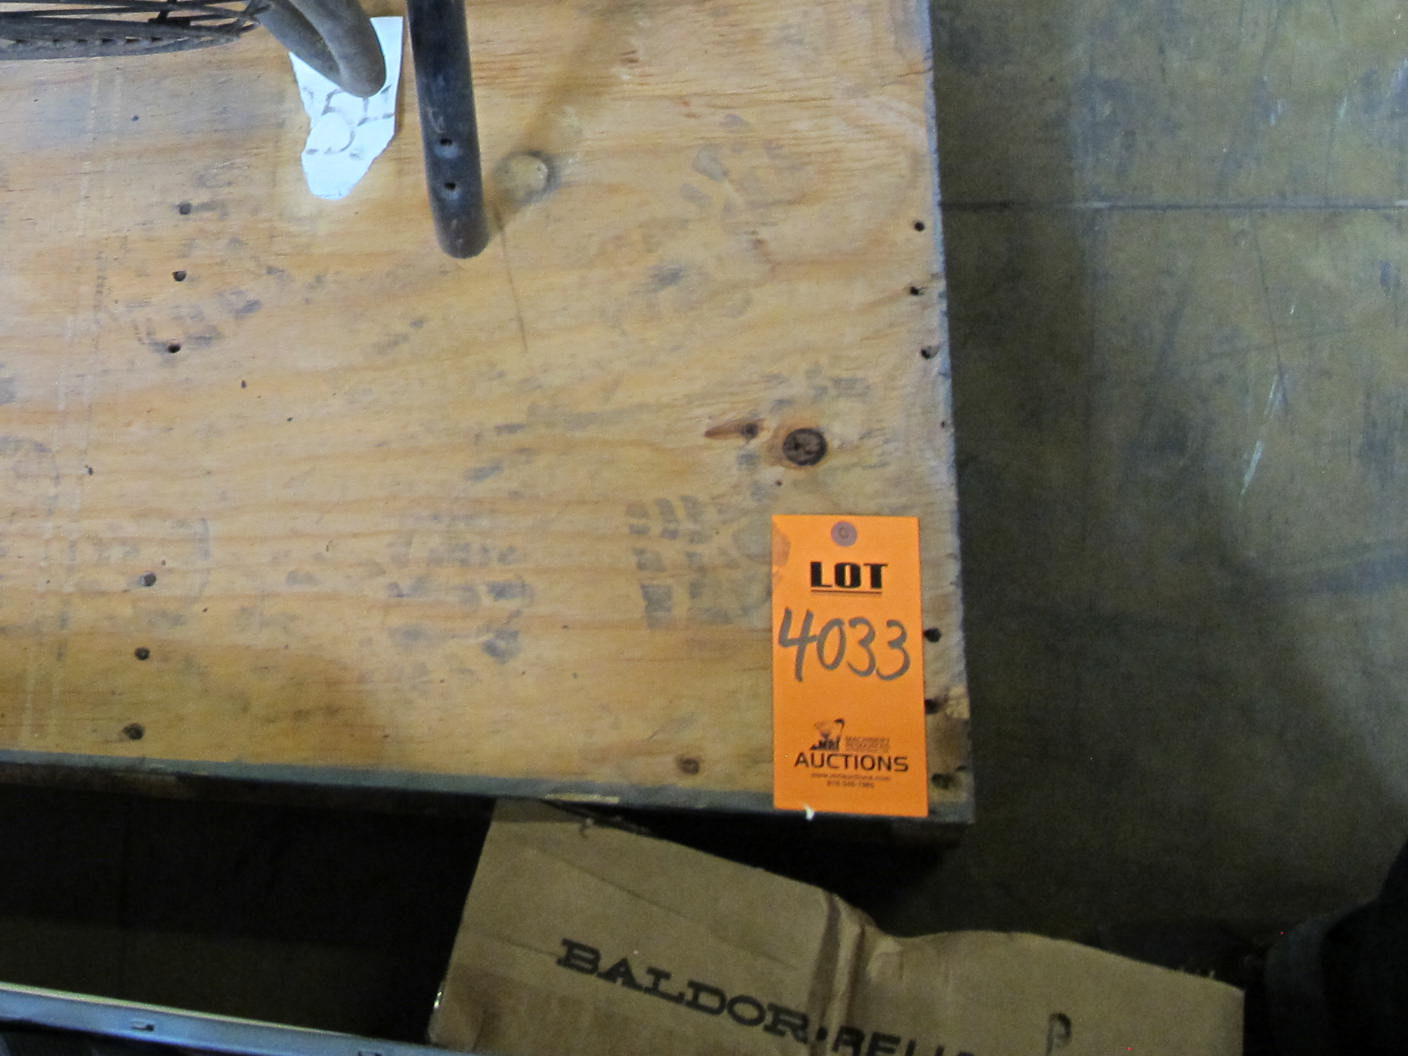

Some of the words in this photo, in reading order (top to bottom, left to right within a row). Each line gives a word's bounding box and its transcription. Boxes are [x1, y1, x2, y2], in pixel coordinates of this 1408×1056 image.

[810, 561, 888, 590] LOT
[777, 607, 911, 682] 4033
[794, 752, 909, 773] AUCTIONS
[556, 938, 811, 1045] BALDOR
